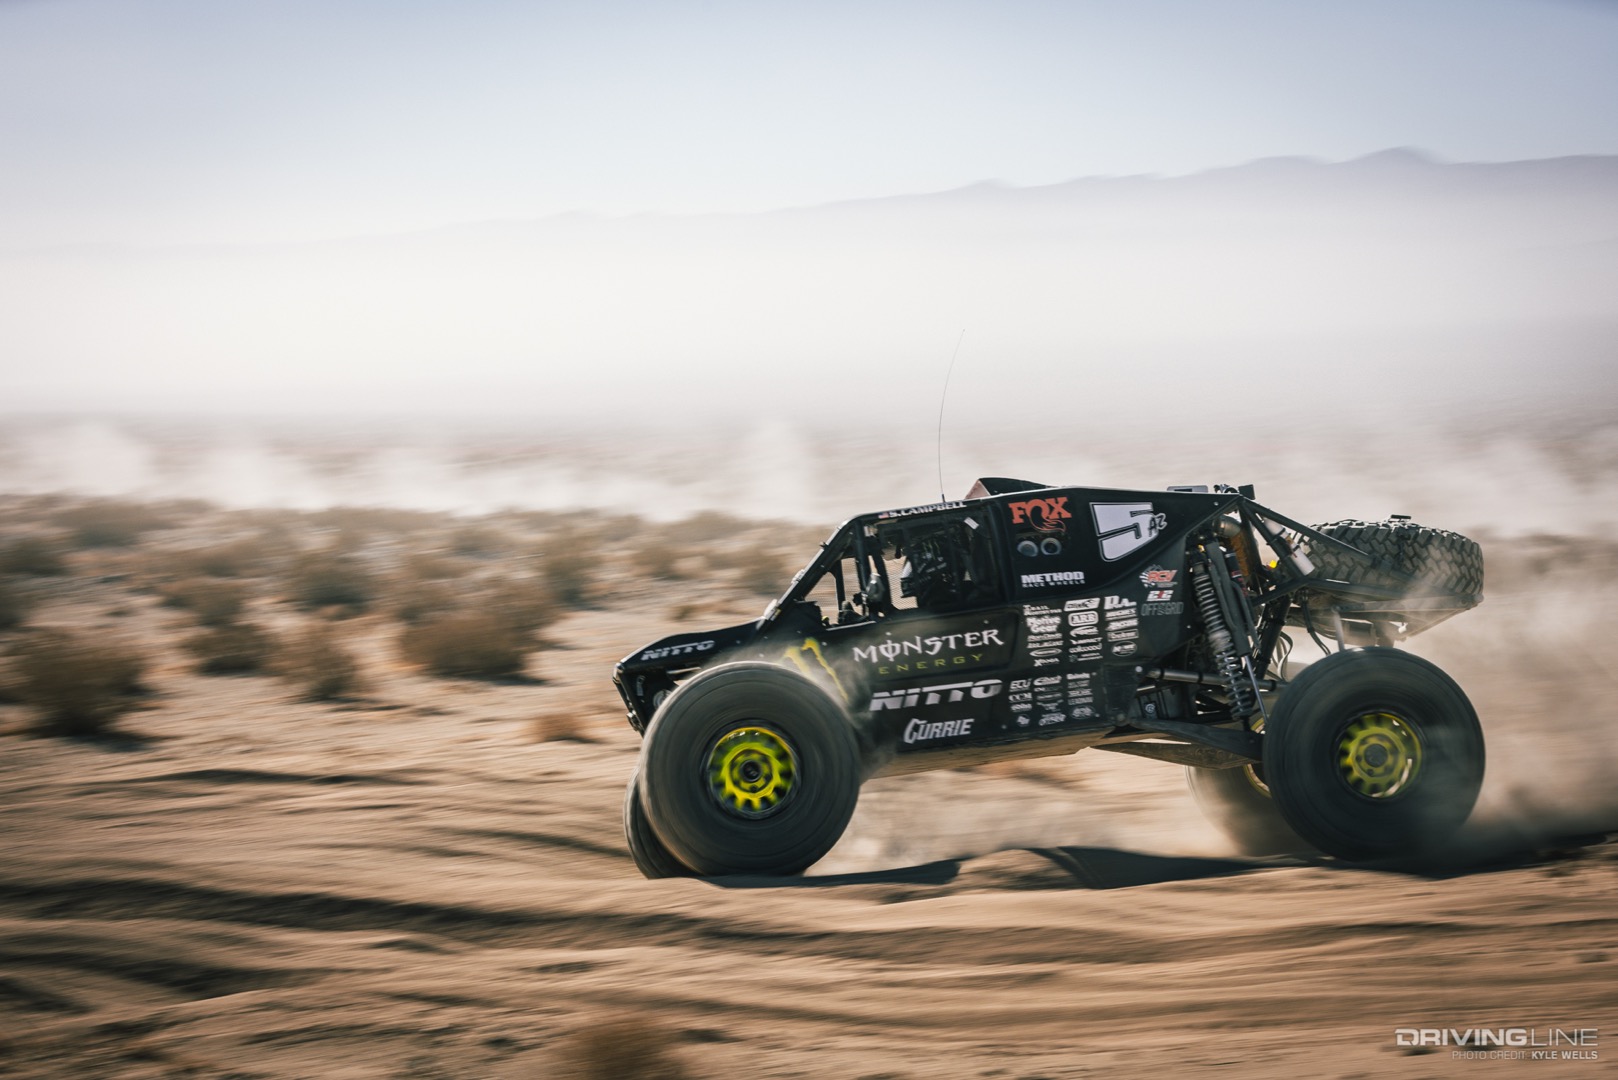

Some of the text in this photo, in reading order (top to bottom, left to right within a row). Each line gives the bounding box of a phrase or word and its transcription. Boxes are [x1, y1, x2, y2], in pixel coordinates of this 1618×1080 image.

[1008, 497, 1072, 530] FOX
[1089, 502, 1160, 562] 5
[1021, 571, 1085, 583] METHOD
[1072, 613, 1096, 624] ARB
[641, 640, 715, 660] NITTO
[852, 629, 1004, 663] MONSTER
[878, 653, 983, 674] ENERGY
[869, 679, 1002, 711] NITTO
[904, 718, 975, 744] CURRIE
